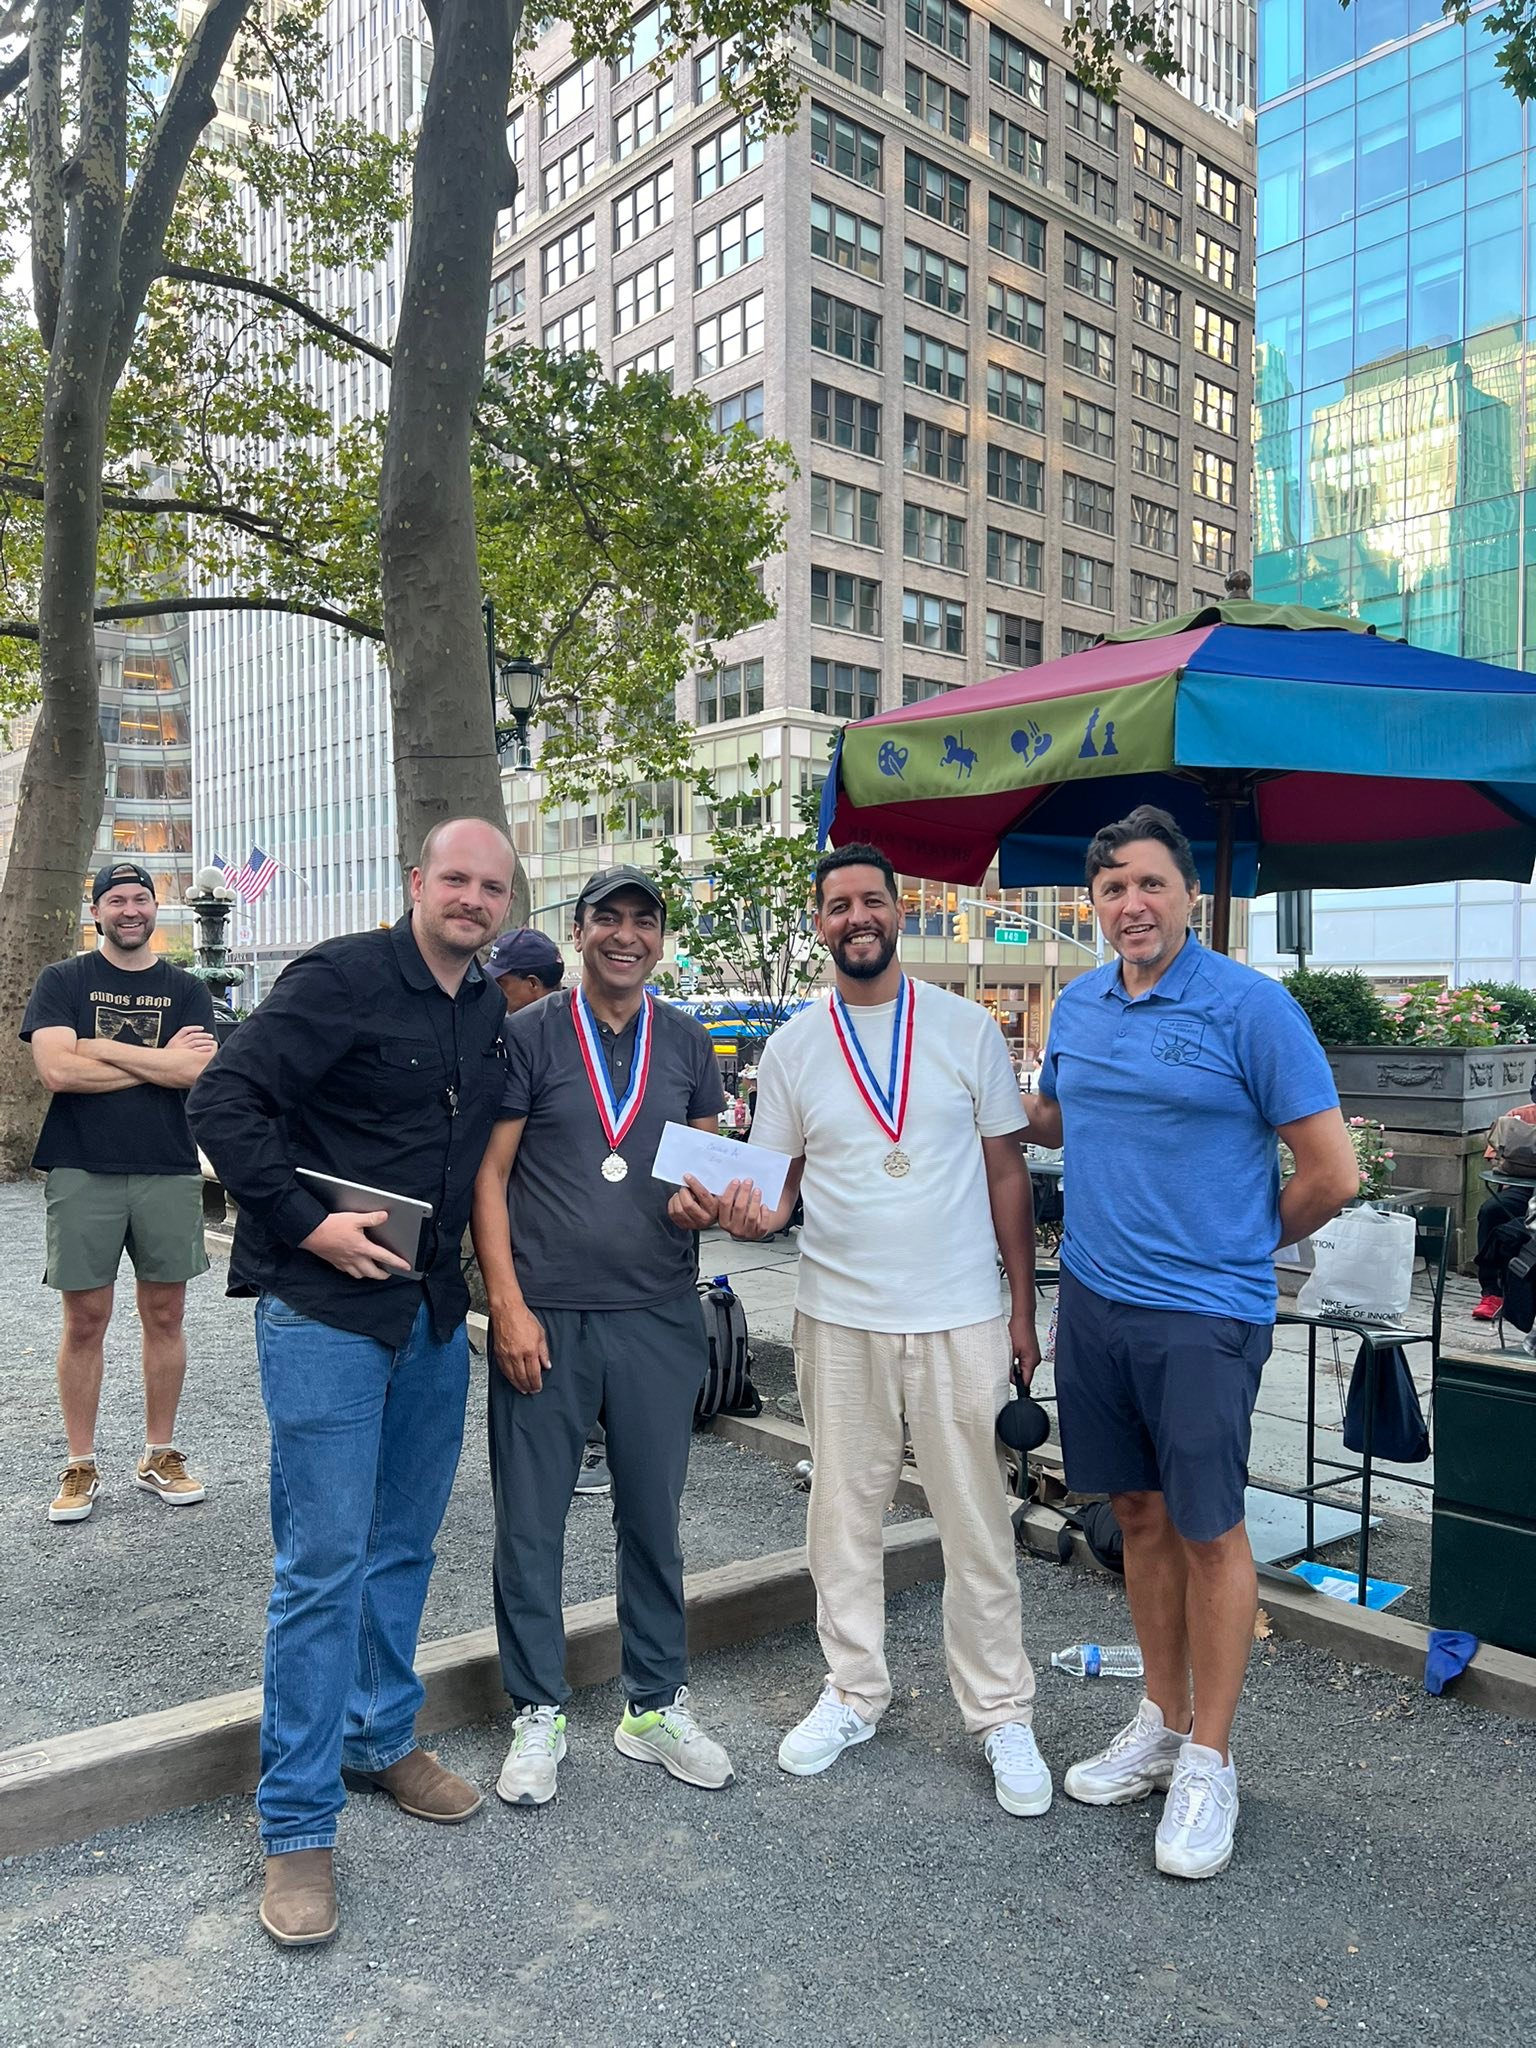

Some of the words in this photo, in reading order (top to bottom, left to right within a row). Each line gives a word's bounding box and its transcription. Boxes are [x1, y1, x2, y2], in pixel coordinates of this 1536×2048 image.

[136, 995, 171, 1009] BAND
[1321, 1298, 1342, 1309] NIKE
[1320, 1306, 1351, 1318] HOUSE
[1353, 1310, 1366, 1318] OF
